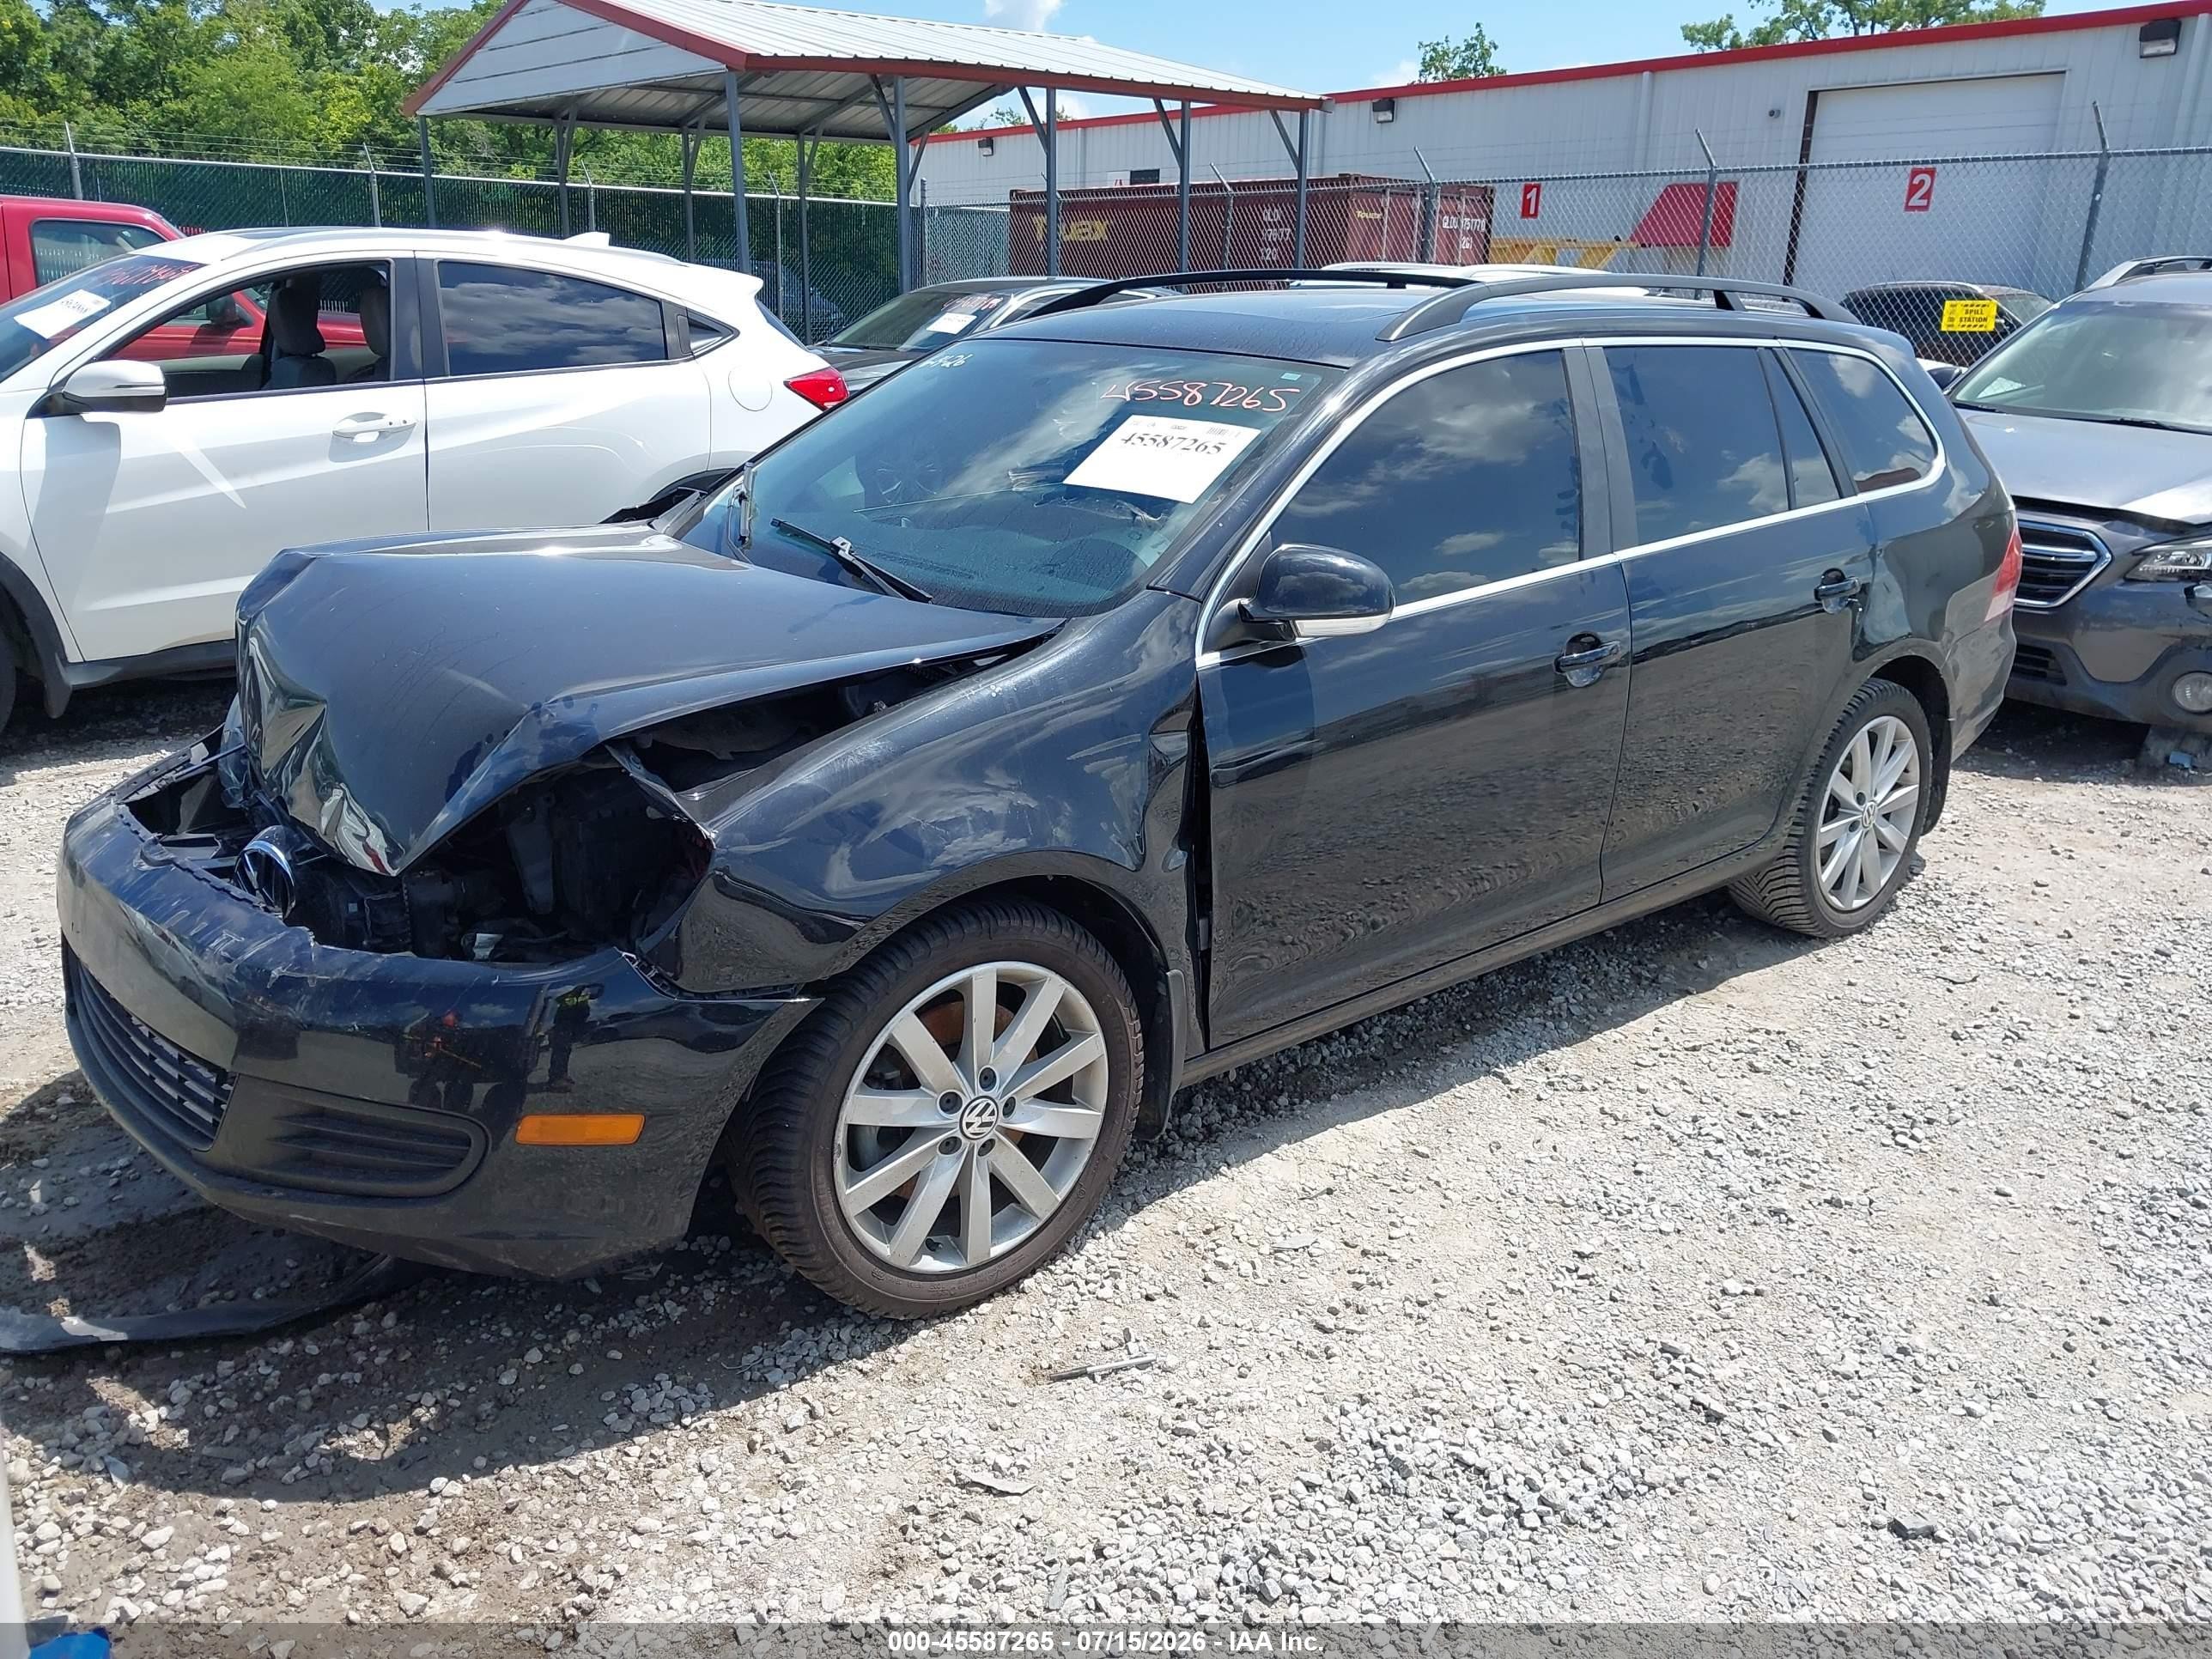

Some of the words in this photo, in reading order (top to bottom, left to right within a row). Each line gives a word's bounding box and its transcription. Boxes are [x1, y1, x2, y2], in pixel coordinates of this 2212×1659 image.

[1527, 187, 1537, 215] 1
[1908, 173, 1931, 206] 2
[1100, 380, 1300, 412] 45587265
[1121, 432, 1228, 455] 45587265
